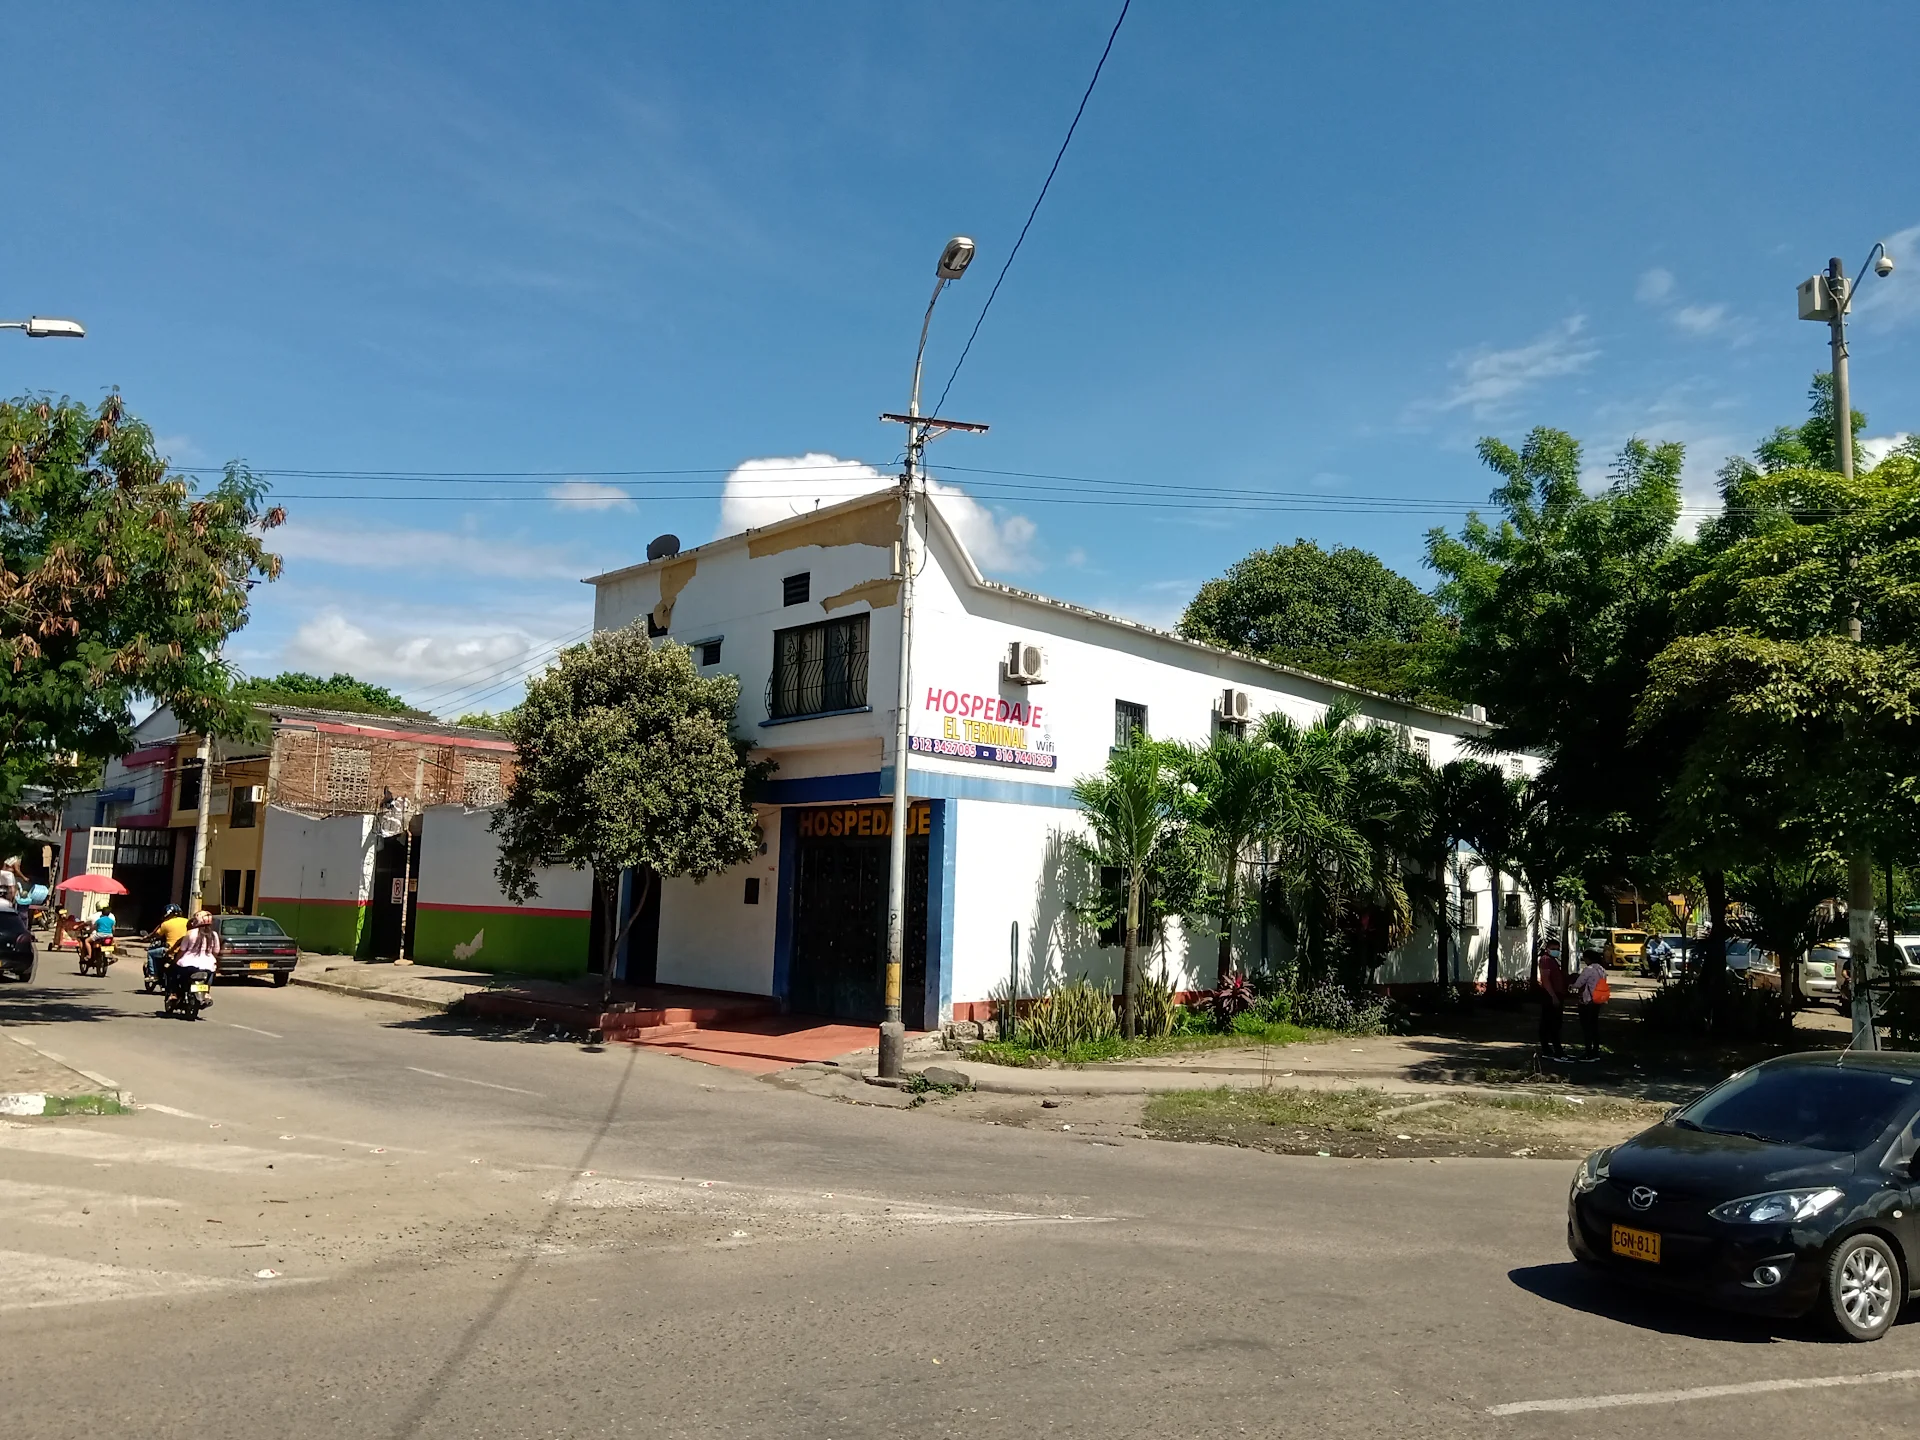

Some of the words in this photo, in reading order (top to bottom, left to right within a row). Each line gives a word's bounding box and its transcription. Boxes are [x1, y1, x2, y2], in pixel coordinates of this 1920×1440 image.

[925, 687, 1043, 728] HOSPEDAJE
[943, 716, 960, 740] EL
[963, 719, 1027, 749] TERMINAL
[1036, 740, 1055, 752] Wifi
[912, 736, 931, 752] 312
[934, 740, 977, 758] 3427085
[995, 749, 1013, 762] 316
[1015, 751, 1053, 767] 7441253
